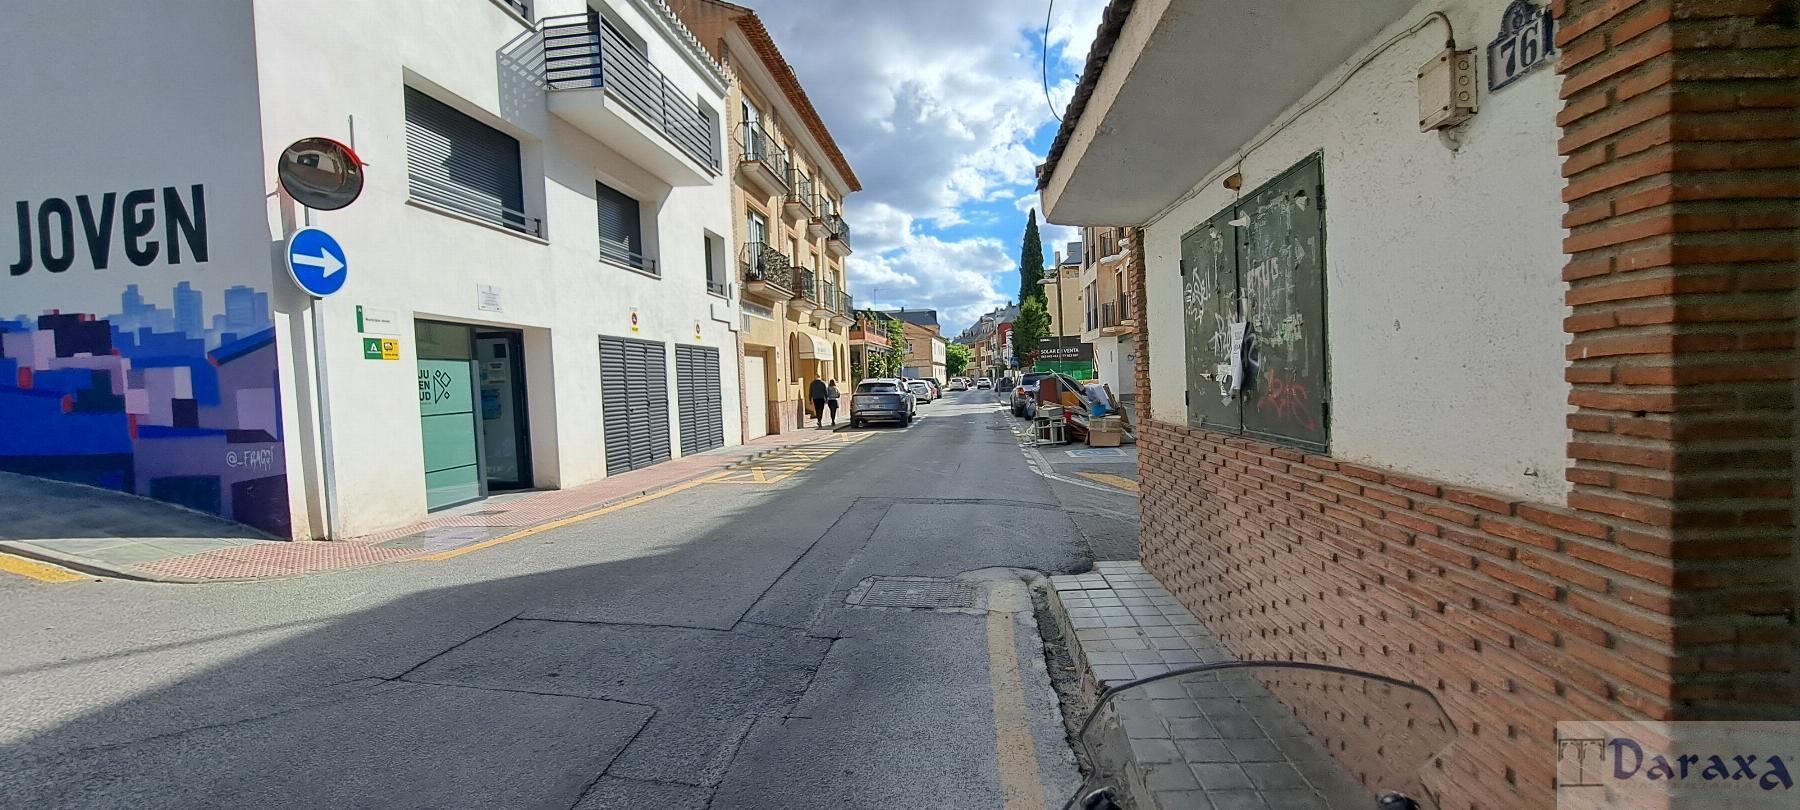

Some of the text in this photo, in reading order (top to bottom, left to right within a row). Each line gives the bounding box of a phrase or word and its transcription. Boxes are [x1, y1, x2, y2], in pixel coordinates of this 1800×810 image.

[1500, 22, 1539, 78] 76
[9, 183, 209, 277] JOVEN
[418, 369, 429, 379] JU
